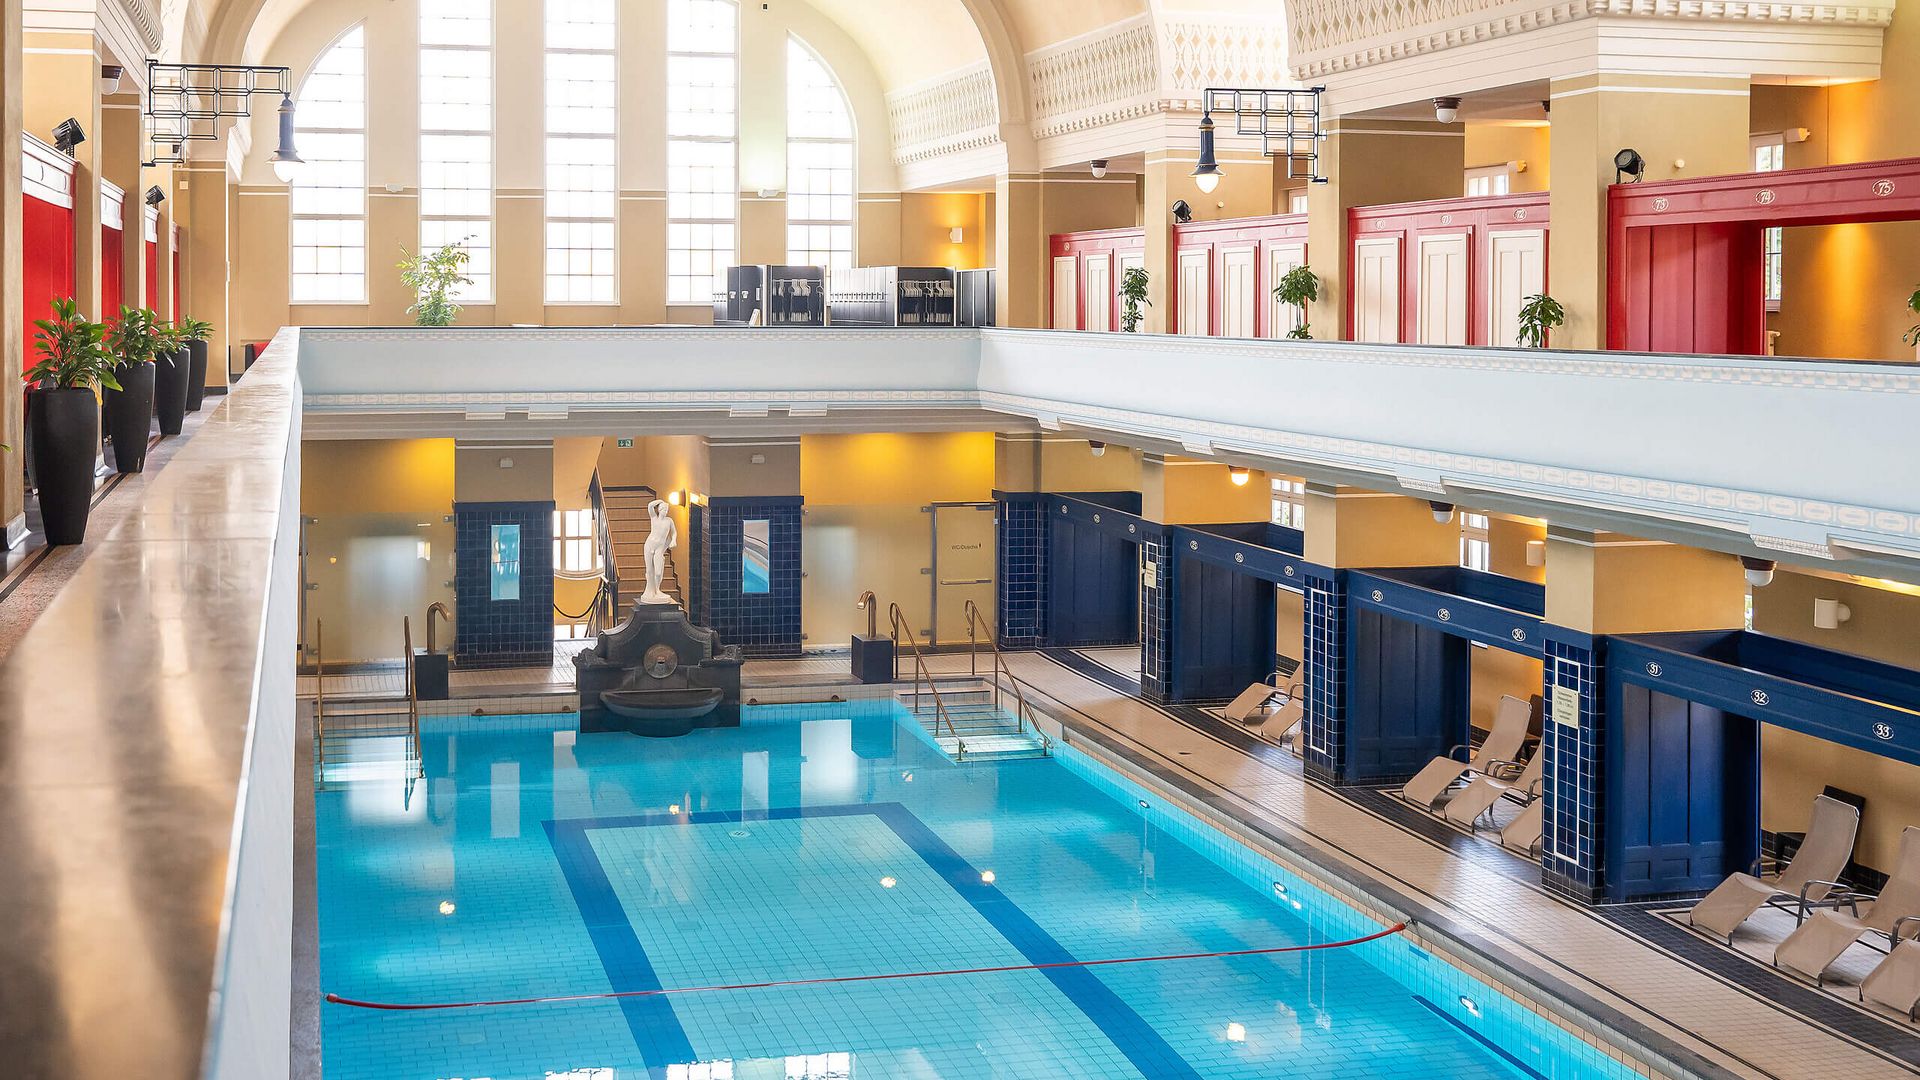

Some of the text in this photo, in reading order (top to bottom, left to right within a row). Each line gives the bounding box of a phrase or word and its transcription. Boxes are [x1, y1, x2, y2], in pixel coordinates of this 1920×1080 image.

[1878, 182, 1891, 195] 75
[1760, 190, 1771, 203] 74
[1655, 199, 1665, 210] 73
[1513, 628, 1523, 640] 30
[1649, 663, 1659, 674] 31
[1753, 691, 1766, 704] 32
[1876, 724, 1890, 737] 33
